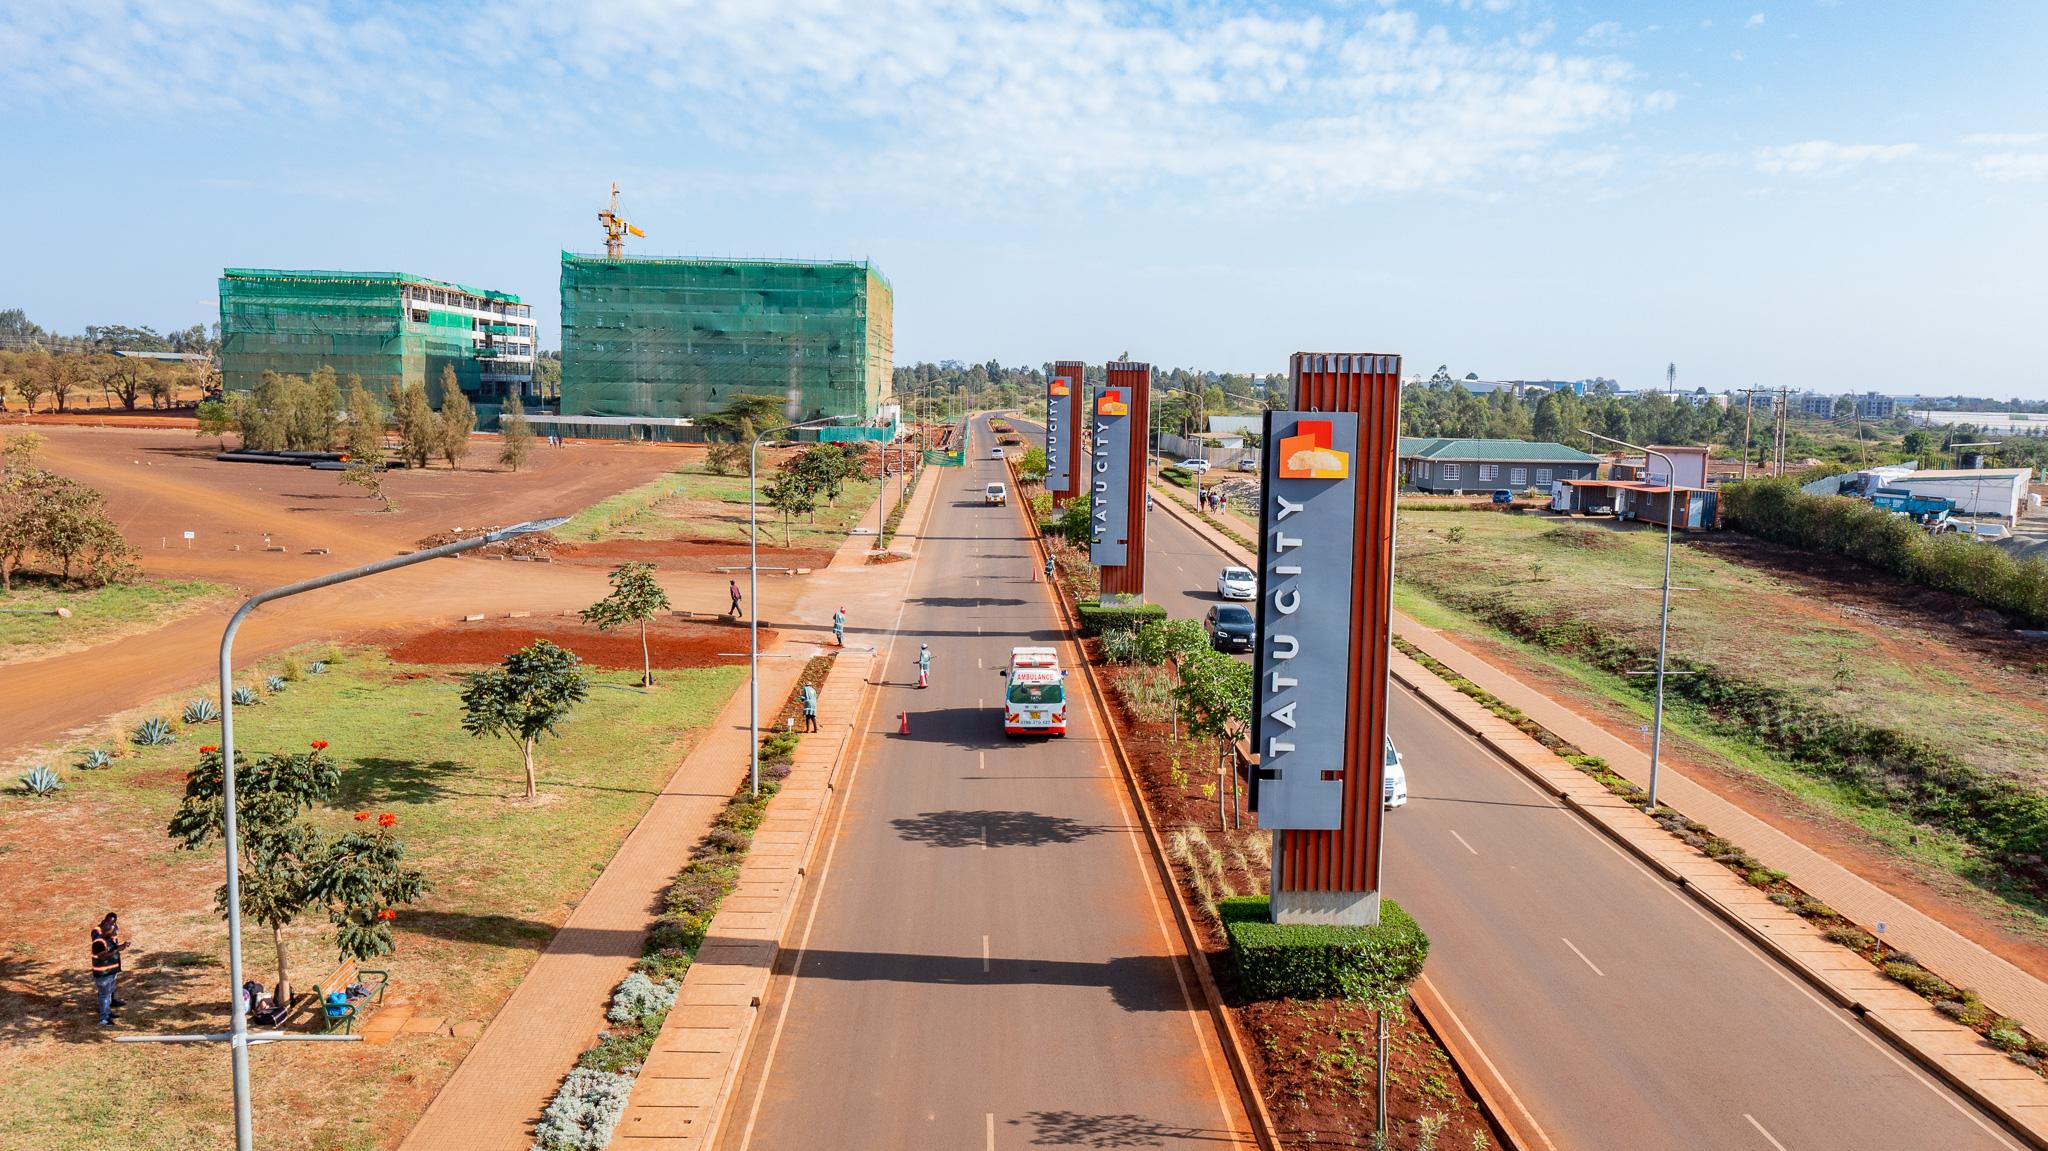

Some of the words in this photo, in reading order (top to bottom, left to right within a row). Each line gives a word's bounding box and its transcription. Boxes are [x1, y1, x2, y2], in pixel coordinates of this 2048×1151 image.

[1049, 399, 1058, 431] CITY
[1049, 436, 1057, 471] TATU
[1096, 422, 1109, 473] CITY
[1094, 481, 1107, 535] TATU
[1274, 495, 1304, 615] CITY
[1269, 634, 1300, 757] TATU
